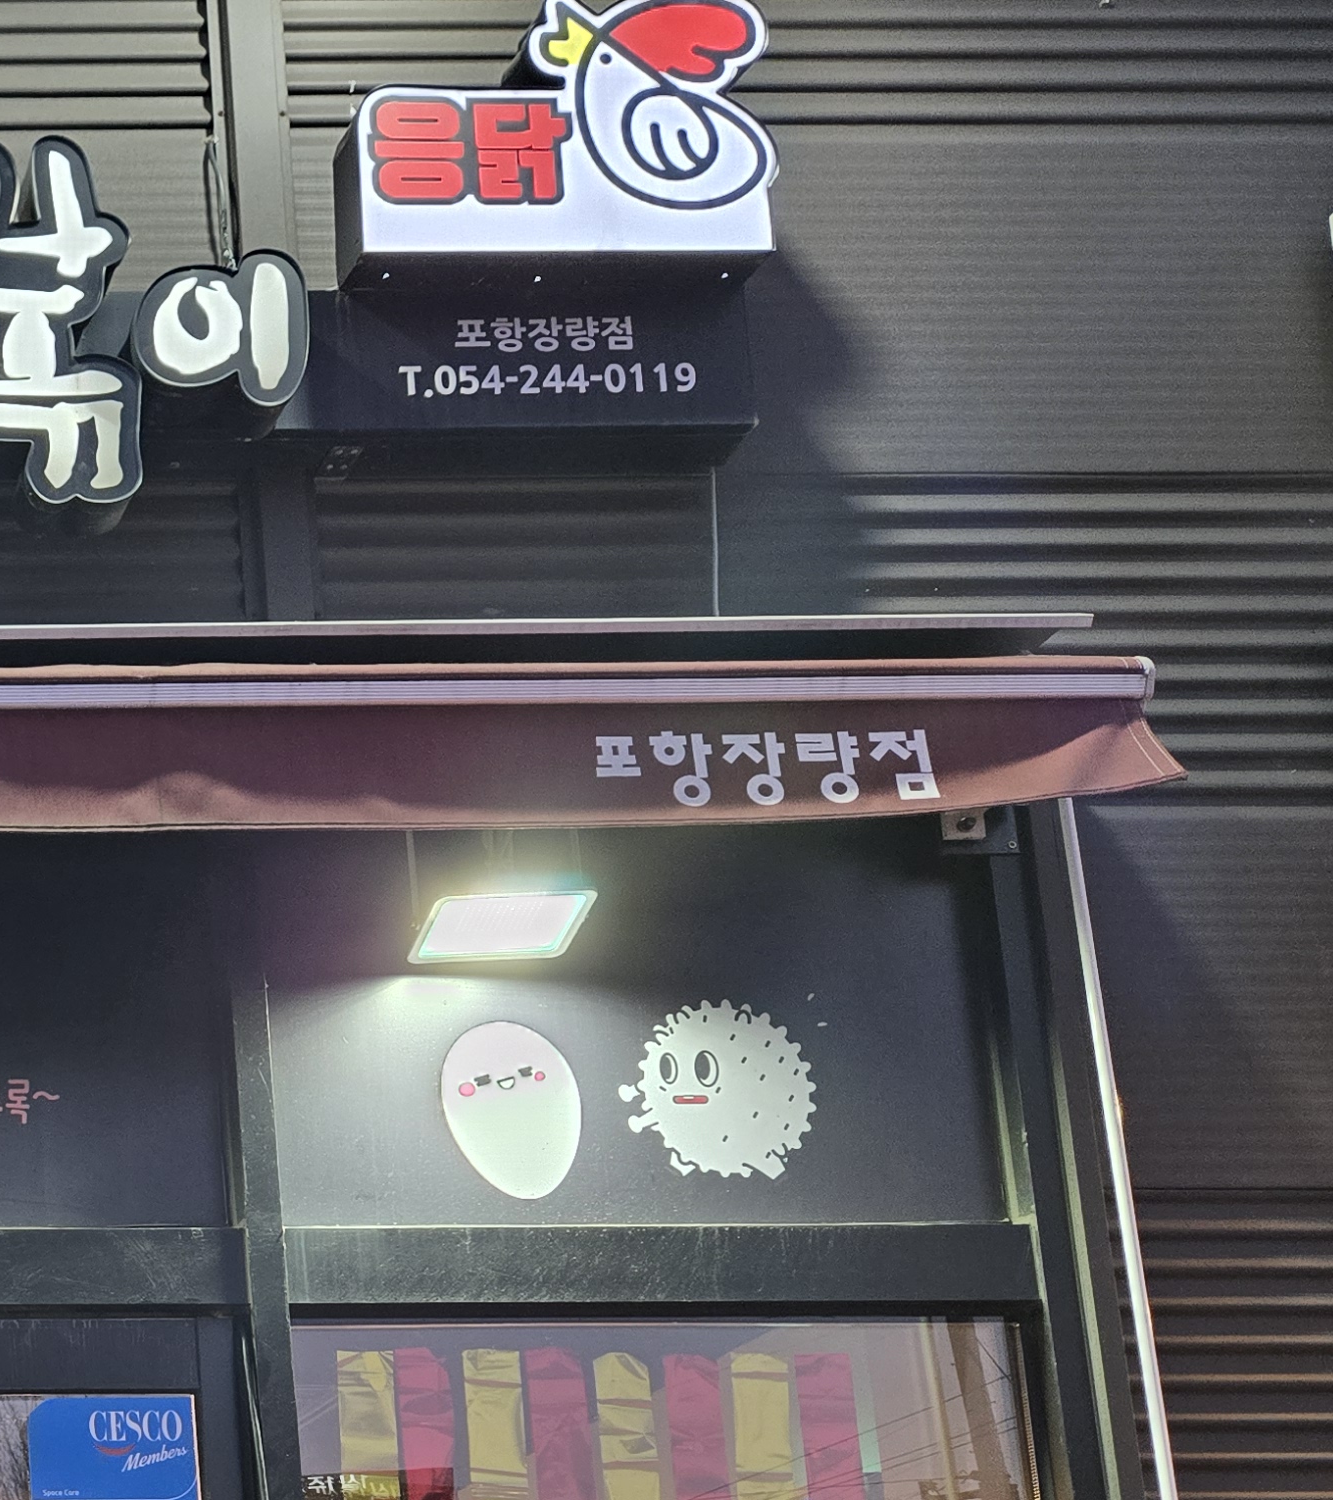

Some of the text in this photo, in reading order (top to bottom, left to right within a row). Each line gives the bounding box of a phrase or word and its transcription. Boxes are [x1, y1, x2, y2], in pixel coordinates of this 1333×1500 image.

[371, 97, 572, 204] 응닭
[452, 316, 635, 355] 포항장량점
[398, 361, 698, 401] T.054-244-0119
[595, 728, 941, 807] 포항장량점
[88, 1409, 183, 1443] CESCO
[121, 1444, 188, 1473] Members
